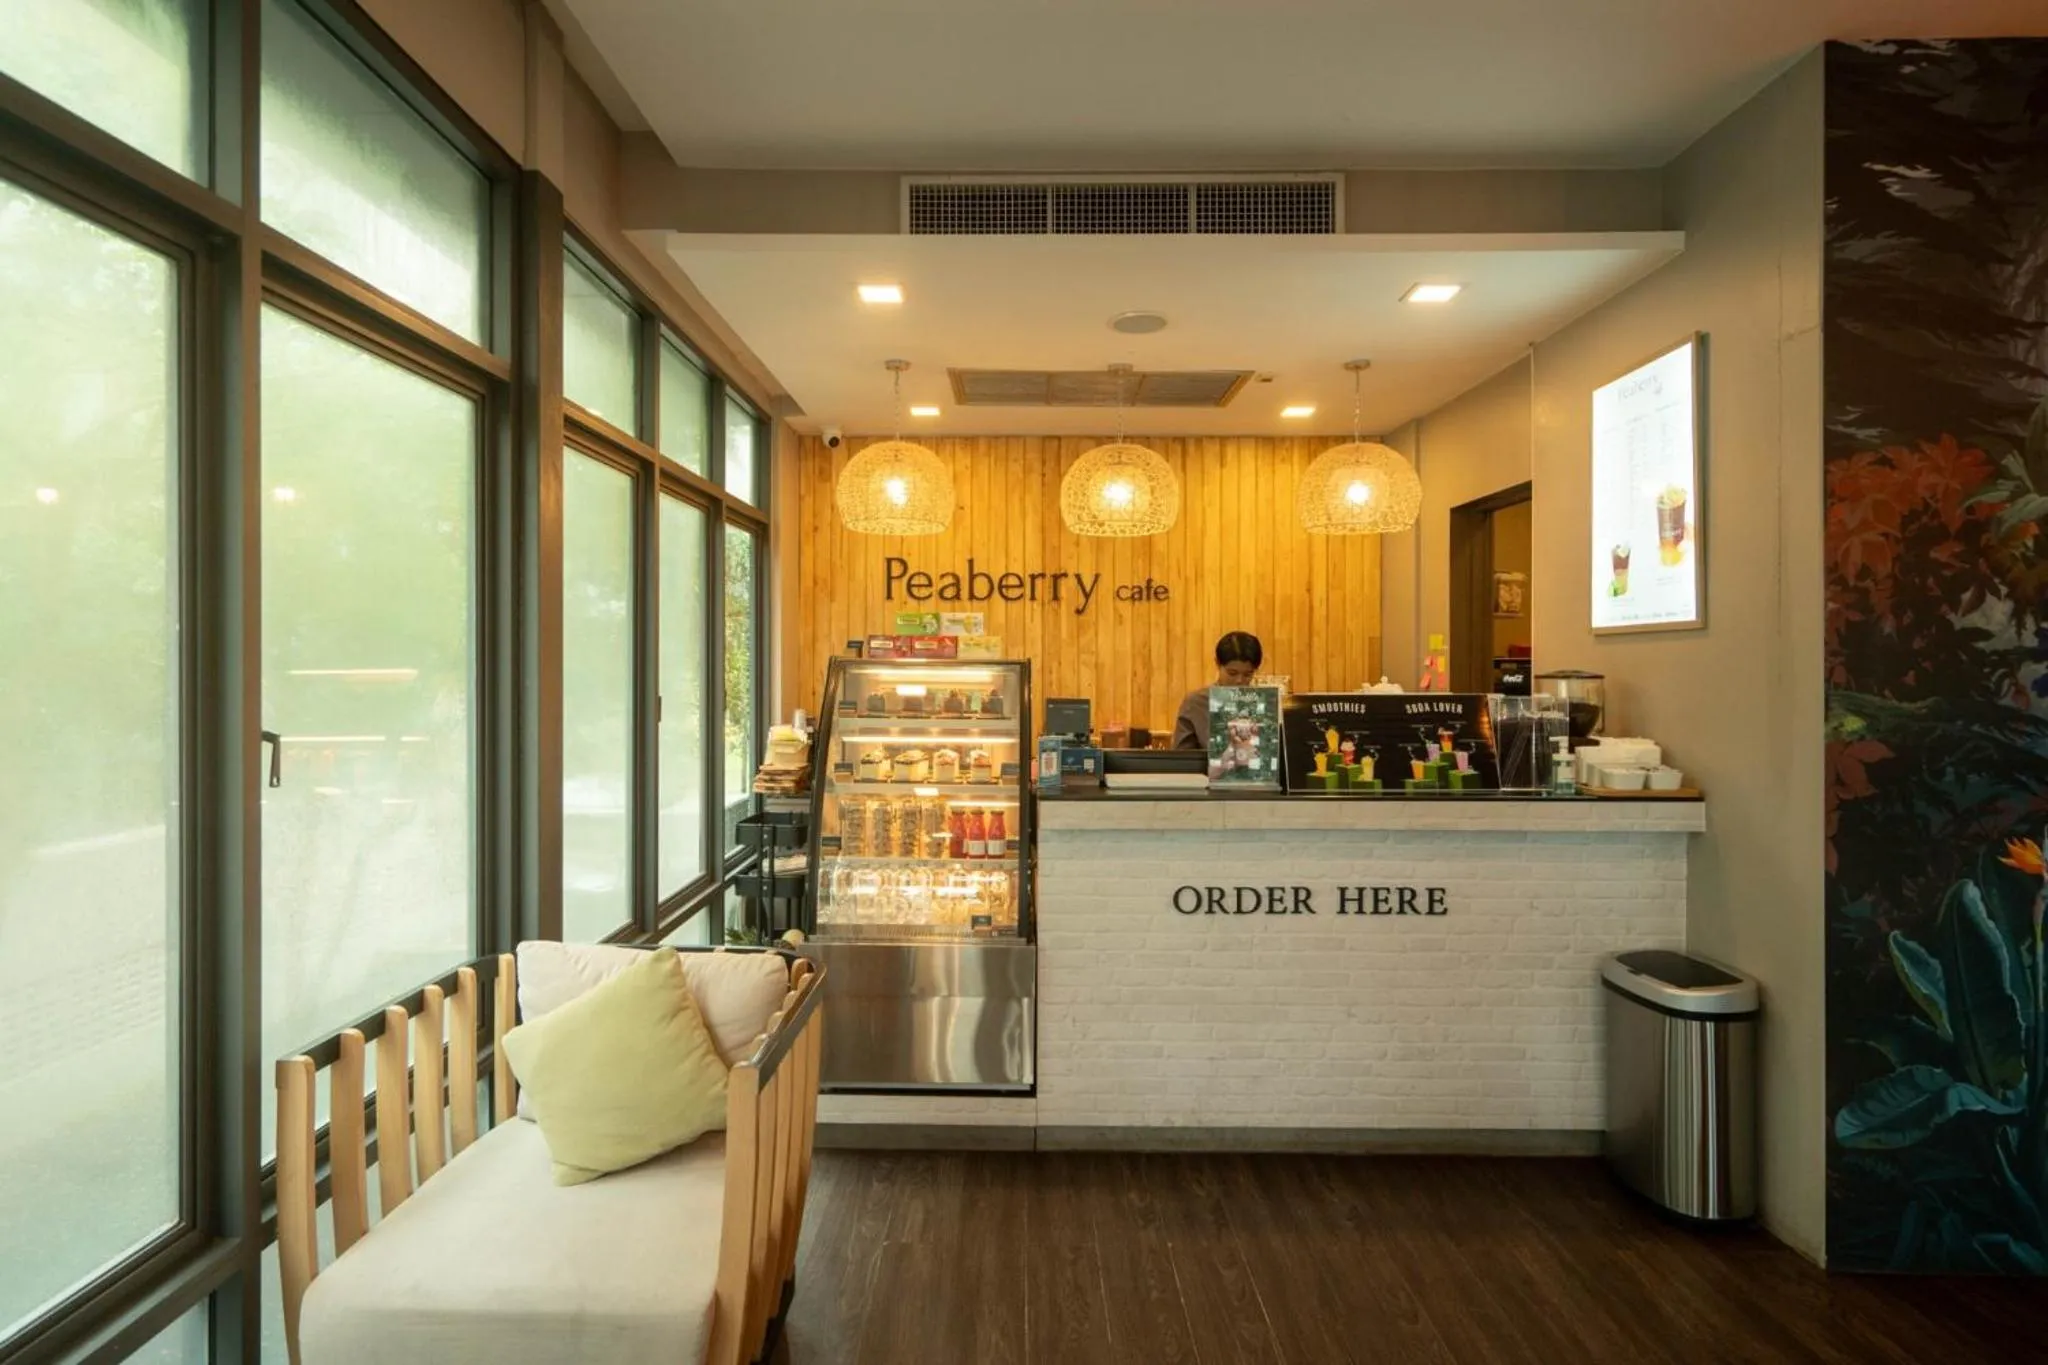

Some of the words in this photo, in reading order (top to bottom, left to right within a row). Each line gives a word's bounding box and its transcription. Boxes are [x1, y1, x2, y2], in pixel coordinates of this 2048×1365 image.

[885, 557, 1101, 614] Peaberry
[1116, 578, 1170, 602] cafe
[1312, 702, 1366, 715] SMOOTHIES
[1433, 702, 1463, 714] LOVER
[1173, 885, 1316, 915] ORDER
[1336, 886, 1449, 916] HERE
